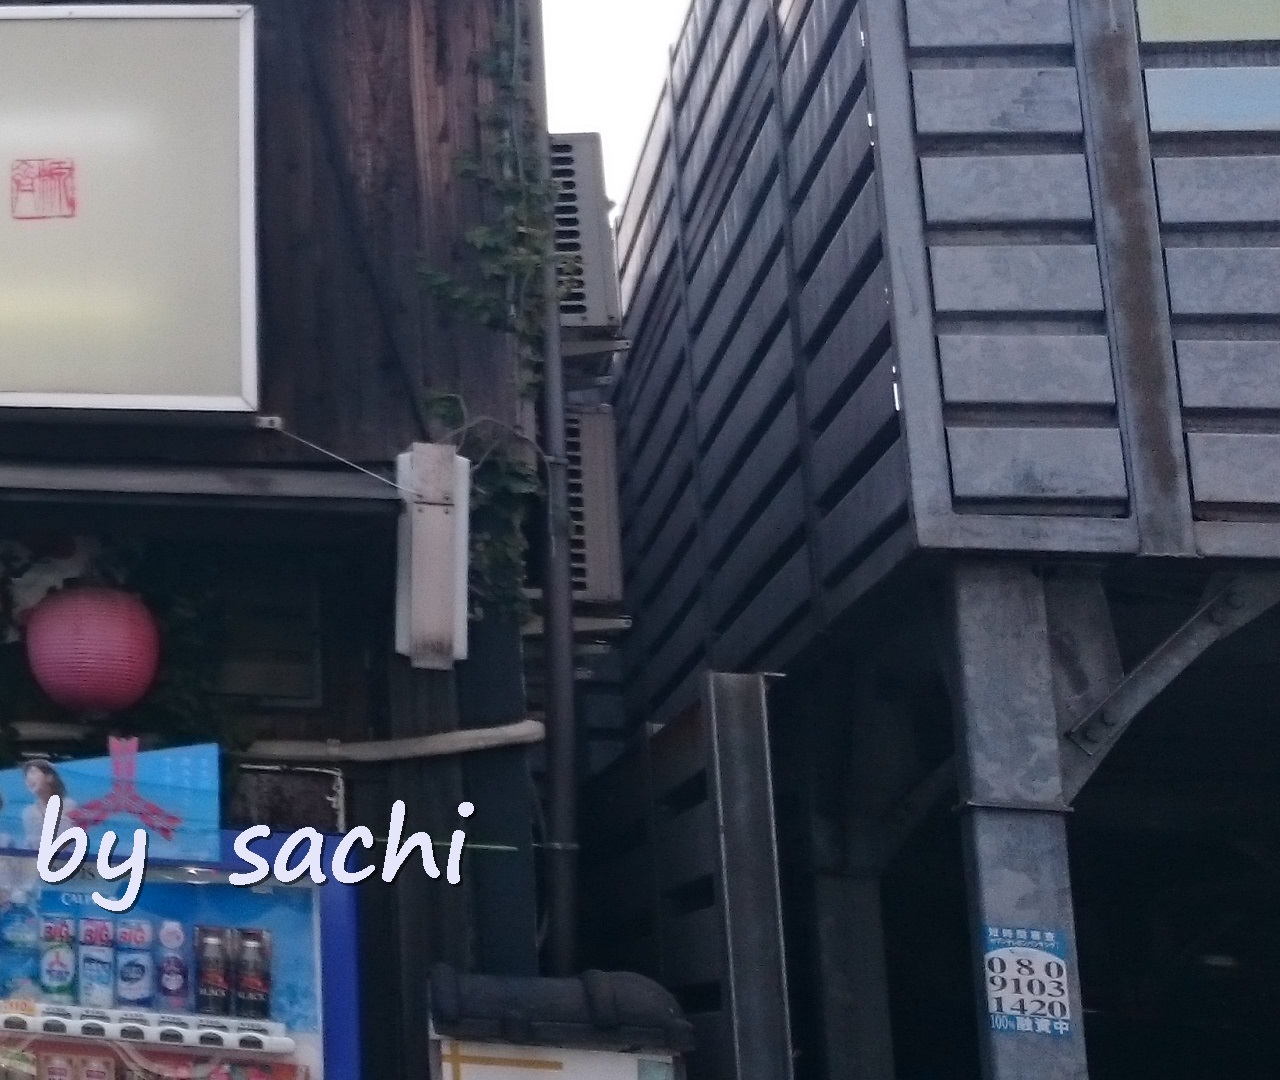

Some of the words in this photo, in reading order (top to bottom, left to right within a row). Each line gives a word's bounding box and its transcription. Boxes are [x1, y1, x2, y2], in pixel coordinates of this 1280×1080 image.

[987, 956, 1065, 979] 080
[989, 975, 1066, 998] 9103
[992, 996, 1067, 1018] 1420
